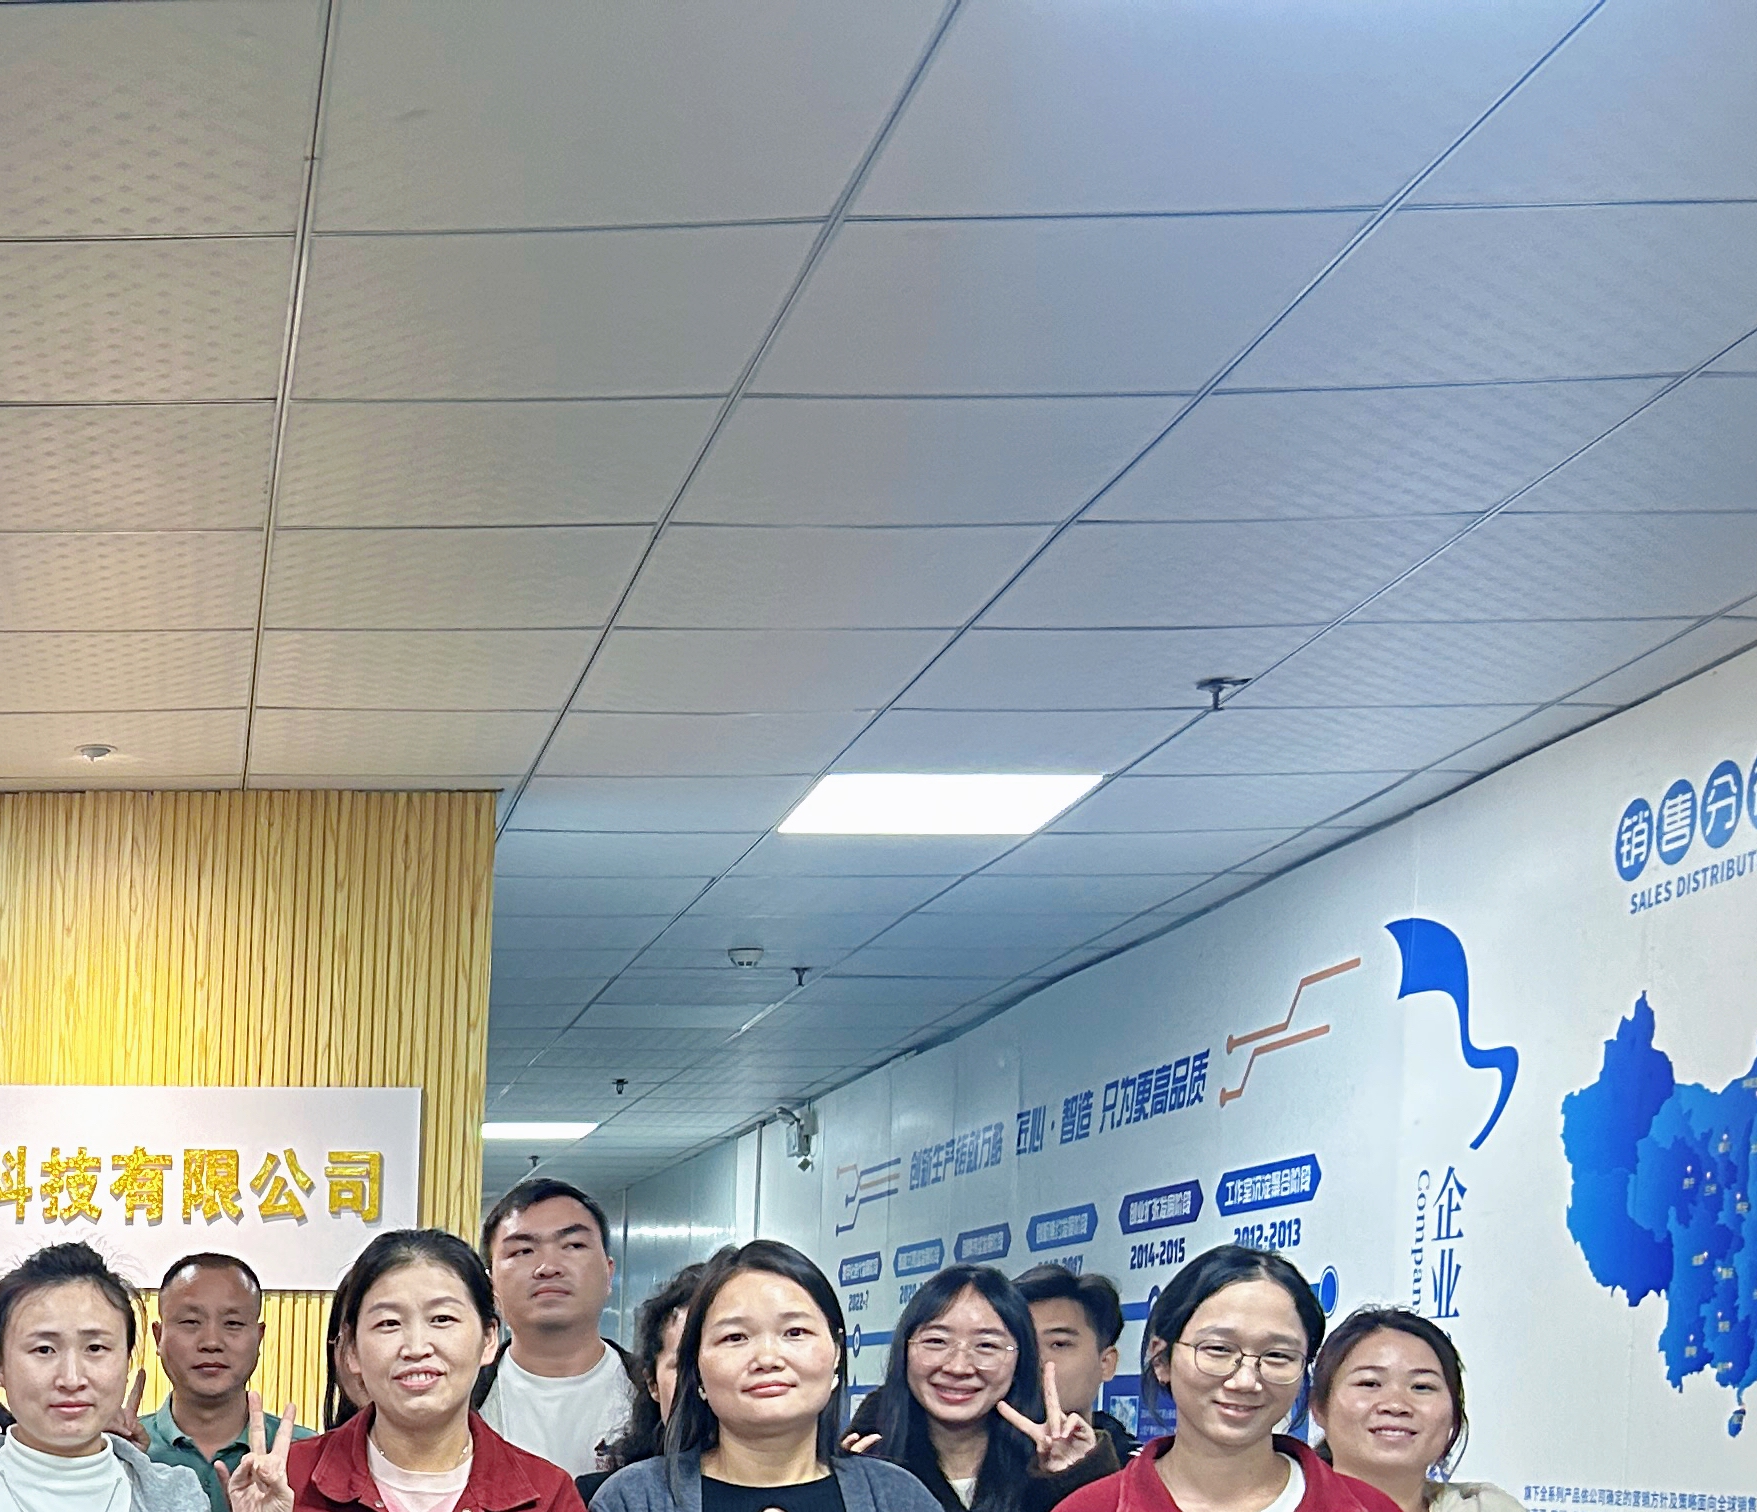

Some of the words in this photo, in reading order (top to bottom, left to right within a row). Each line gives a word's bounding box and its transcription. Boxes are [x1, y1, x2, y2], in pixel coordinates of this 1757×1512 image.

[1619, 765, 1757, 869] 销售分
[1629, 877, 1673, 915] SALES
[1099, 1048, 1210, 1134] 只为更高品质
[1129, 1237, 1186, 1270] 2014-2015
[1234, 1217, 1302, 1250] 2012-2013
[1411, 1169, 1431, 1315] Compan
[1429, 1165, 1468, 1341] 企业
